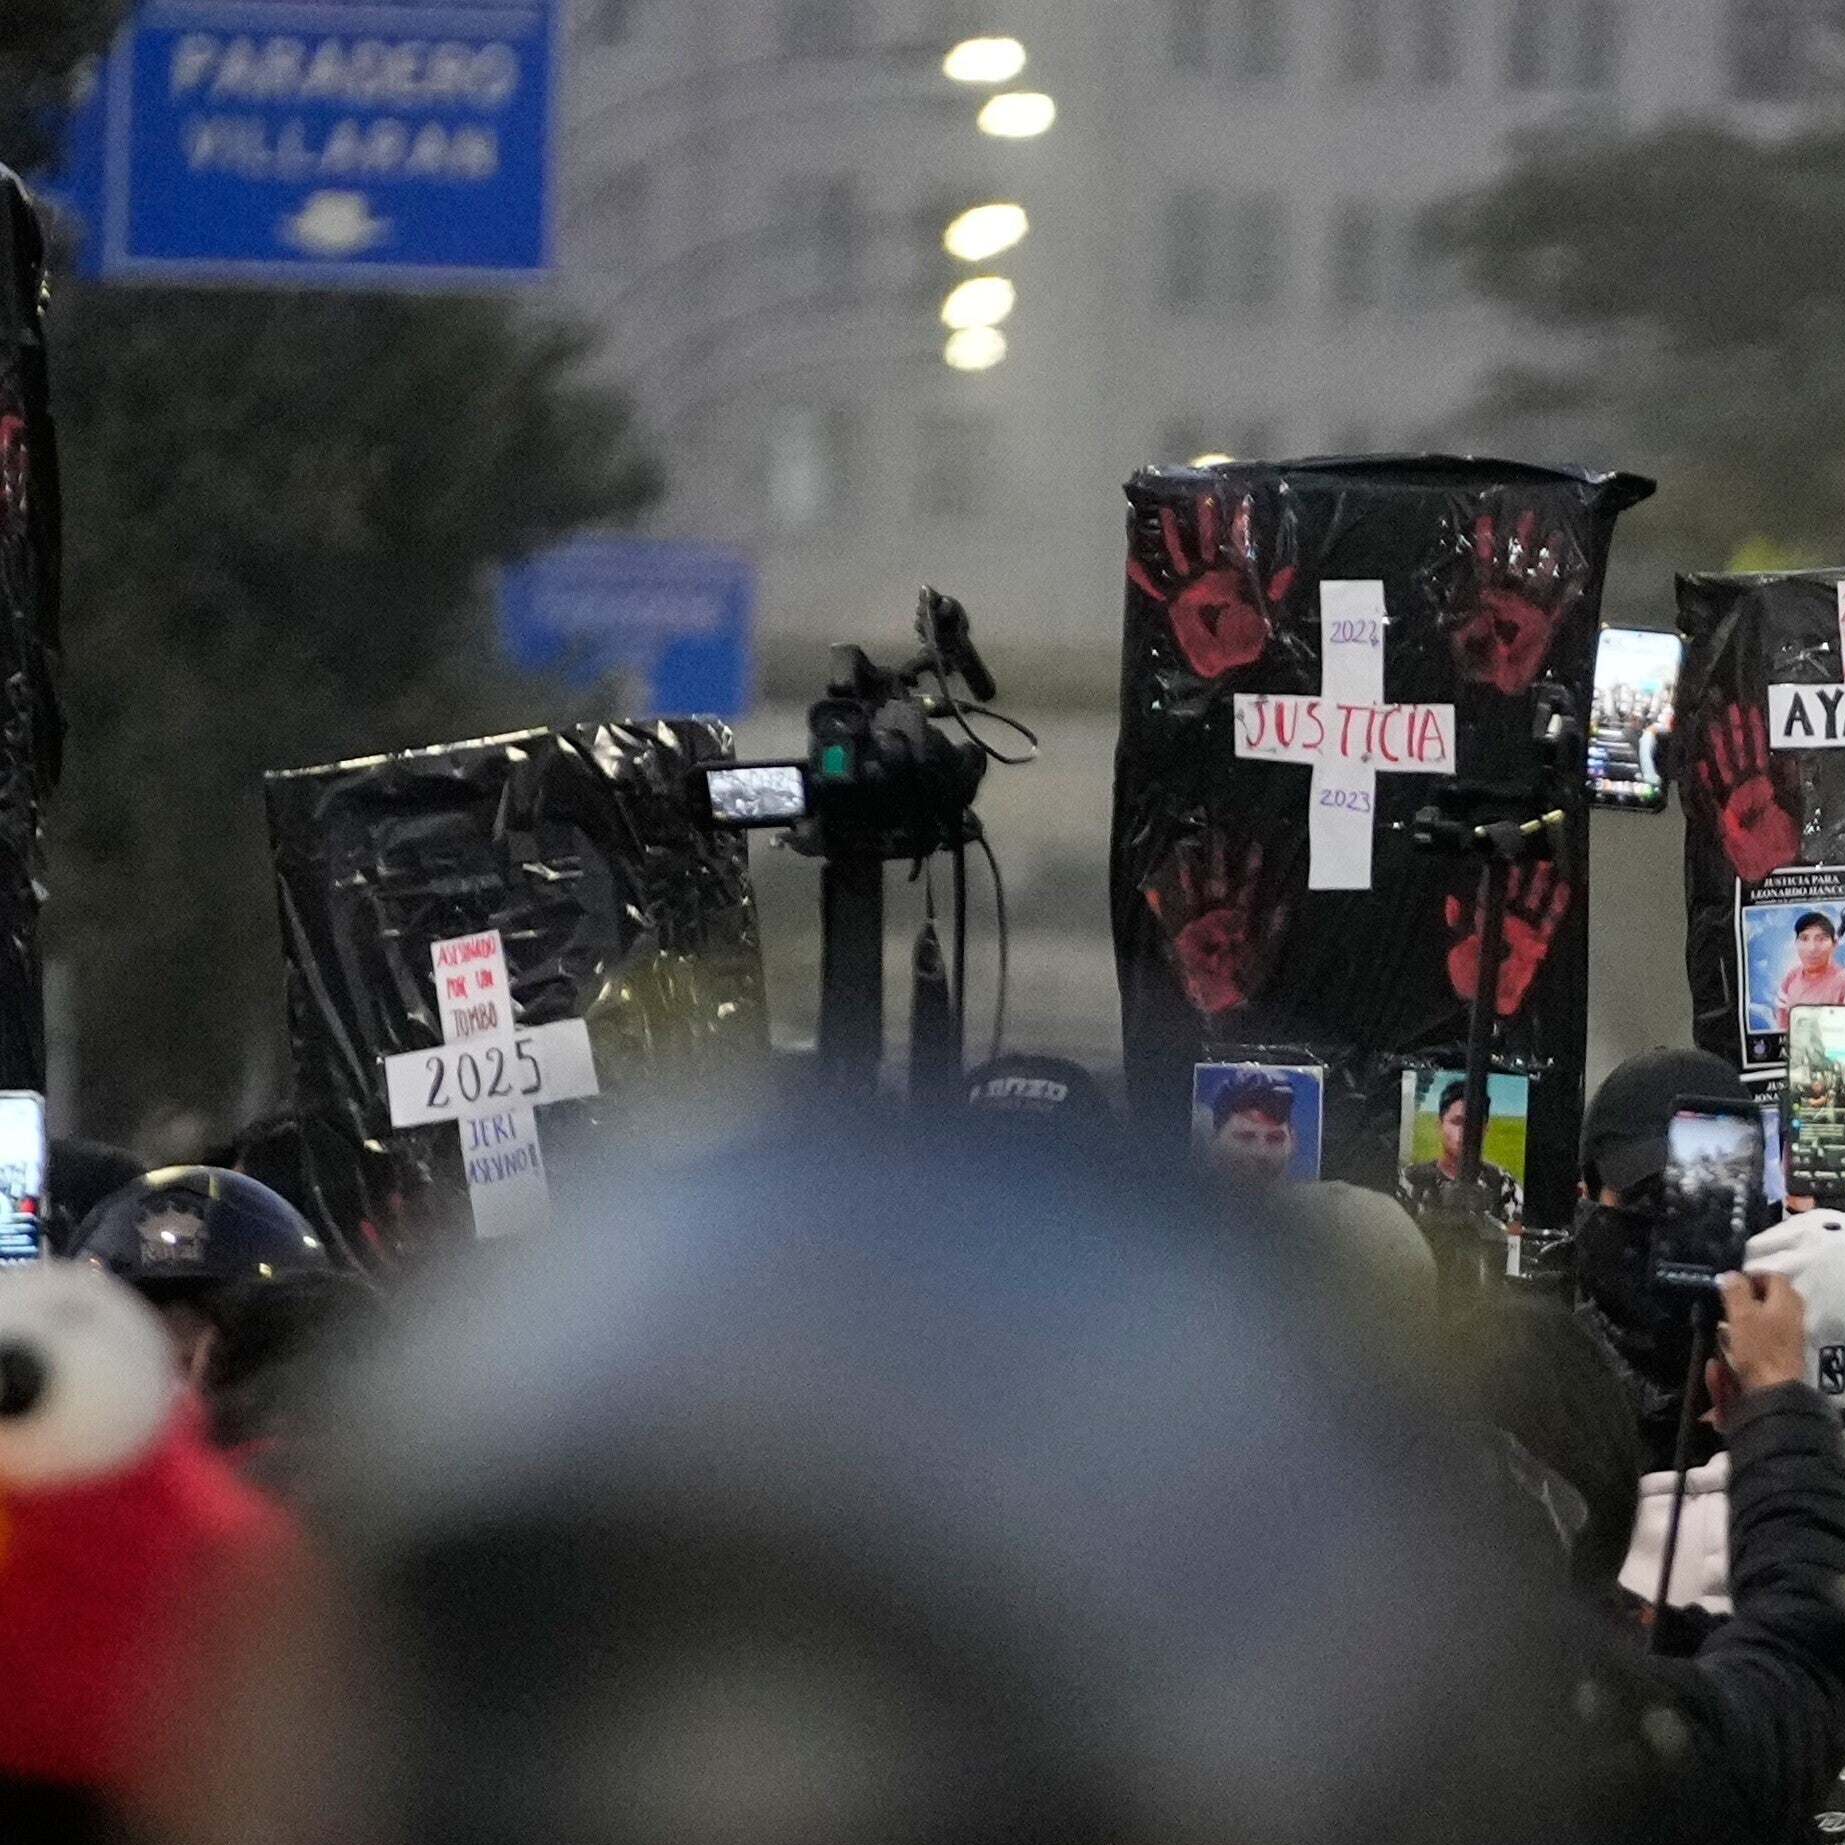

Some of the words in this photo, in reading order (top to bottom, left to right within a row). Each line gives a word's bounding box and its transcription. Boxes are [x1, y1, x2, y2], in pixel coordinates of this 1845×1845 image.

[172, 32, 520, 103] PARADERO
[185, 112, 498, 180] VILLARAN
[1245, 699, 1447, 763] JUSTICIA
[1319, 788, 1371, 813] 2023
[1751, 886, 1808, 899] LEONARDO
[1764, 876, 1811, 887] JUSTICIA
[1811, 873, 1840, 884] PARA
[453, 1001, 499, 1037] TOMBO
[425, 1038, 543, 1108] 2025
